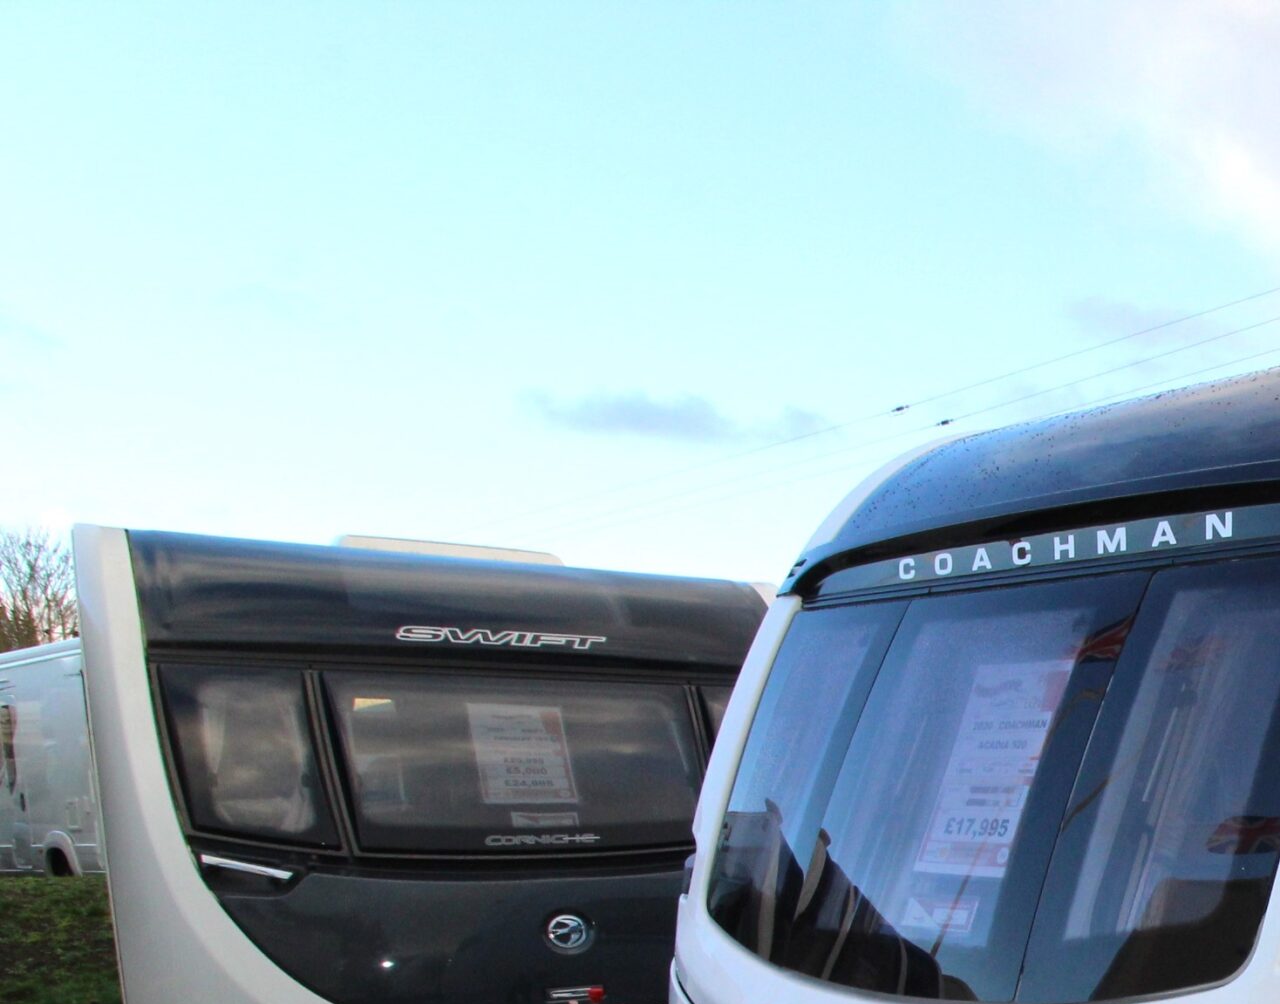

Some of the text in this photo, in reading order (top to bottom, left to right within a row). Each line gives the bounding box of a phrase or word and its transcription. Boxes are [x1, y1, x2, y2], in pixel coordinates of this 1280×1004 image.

[898, 511, 1233, 580] COACHMAN
[396, 625, 606, 649] SWIFT
[485, 833, 597, 846] CORNICHE
[944, 817, 1009, 839] £17,995
